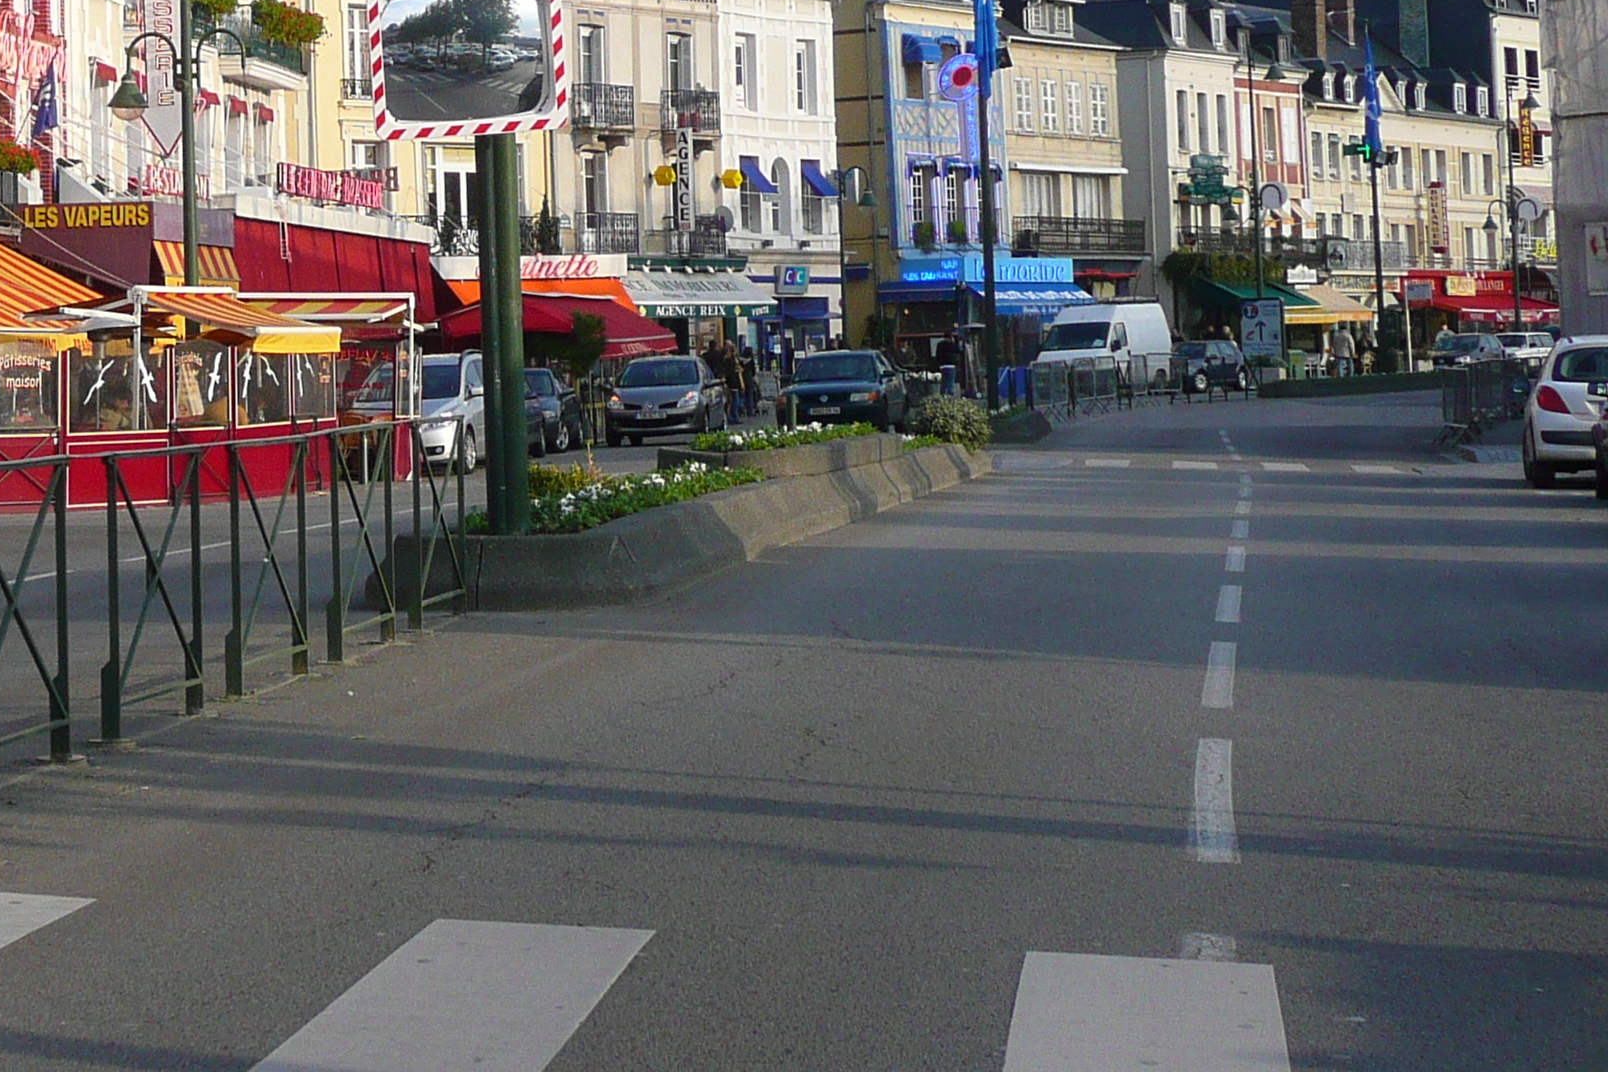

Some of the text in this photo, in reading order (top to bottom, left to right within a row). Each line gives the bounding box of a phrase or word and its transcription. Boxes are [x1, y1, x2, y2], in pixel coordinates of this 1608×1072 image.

[677, 131, 690, 221] AGENCE
[24, 204, 150, 229] LES VAPEURS
[655, 304, 727, 317] AGENCE REIX
[5, 373, 43, 389] maison
